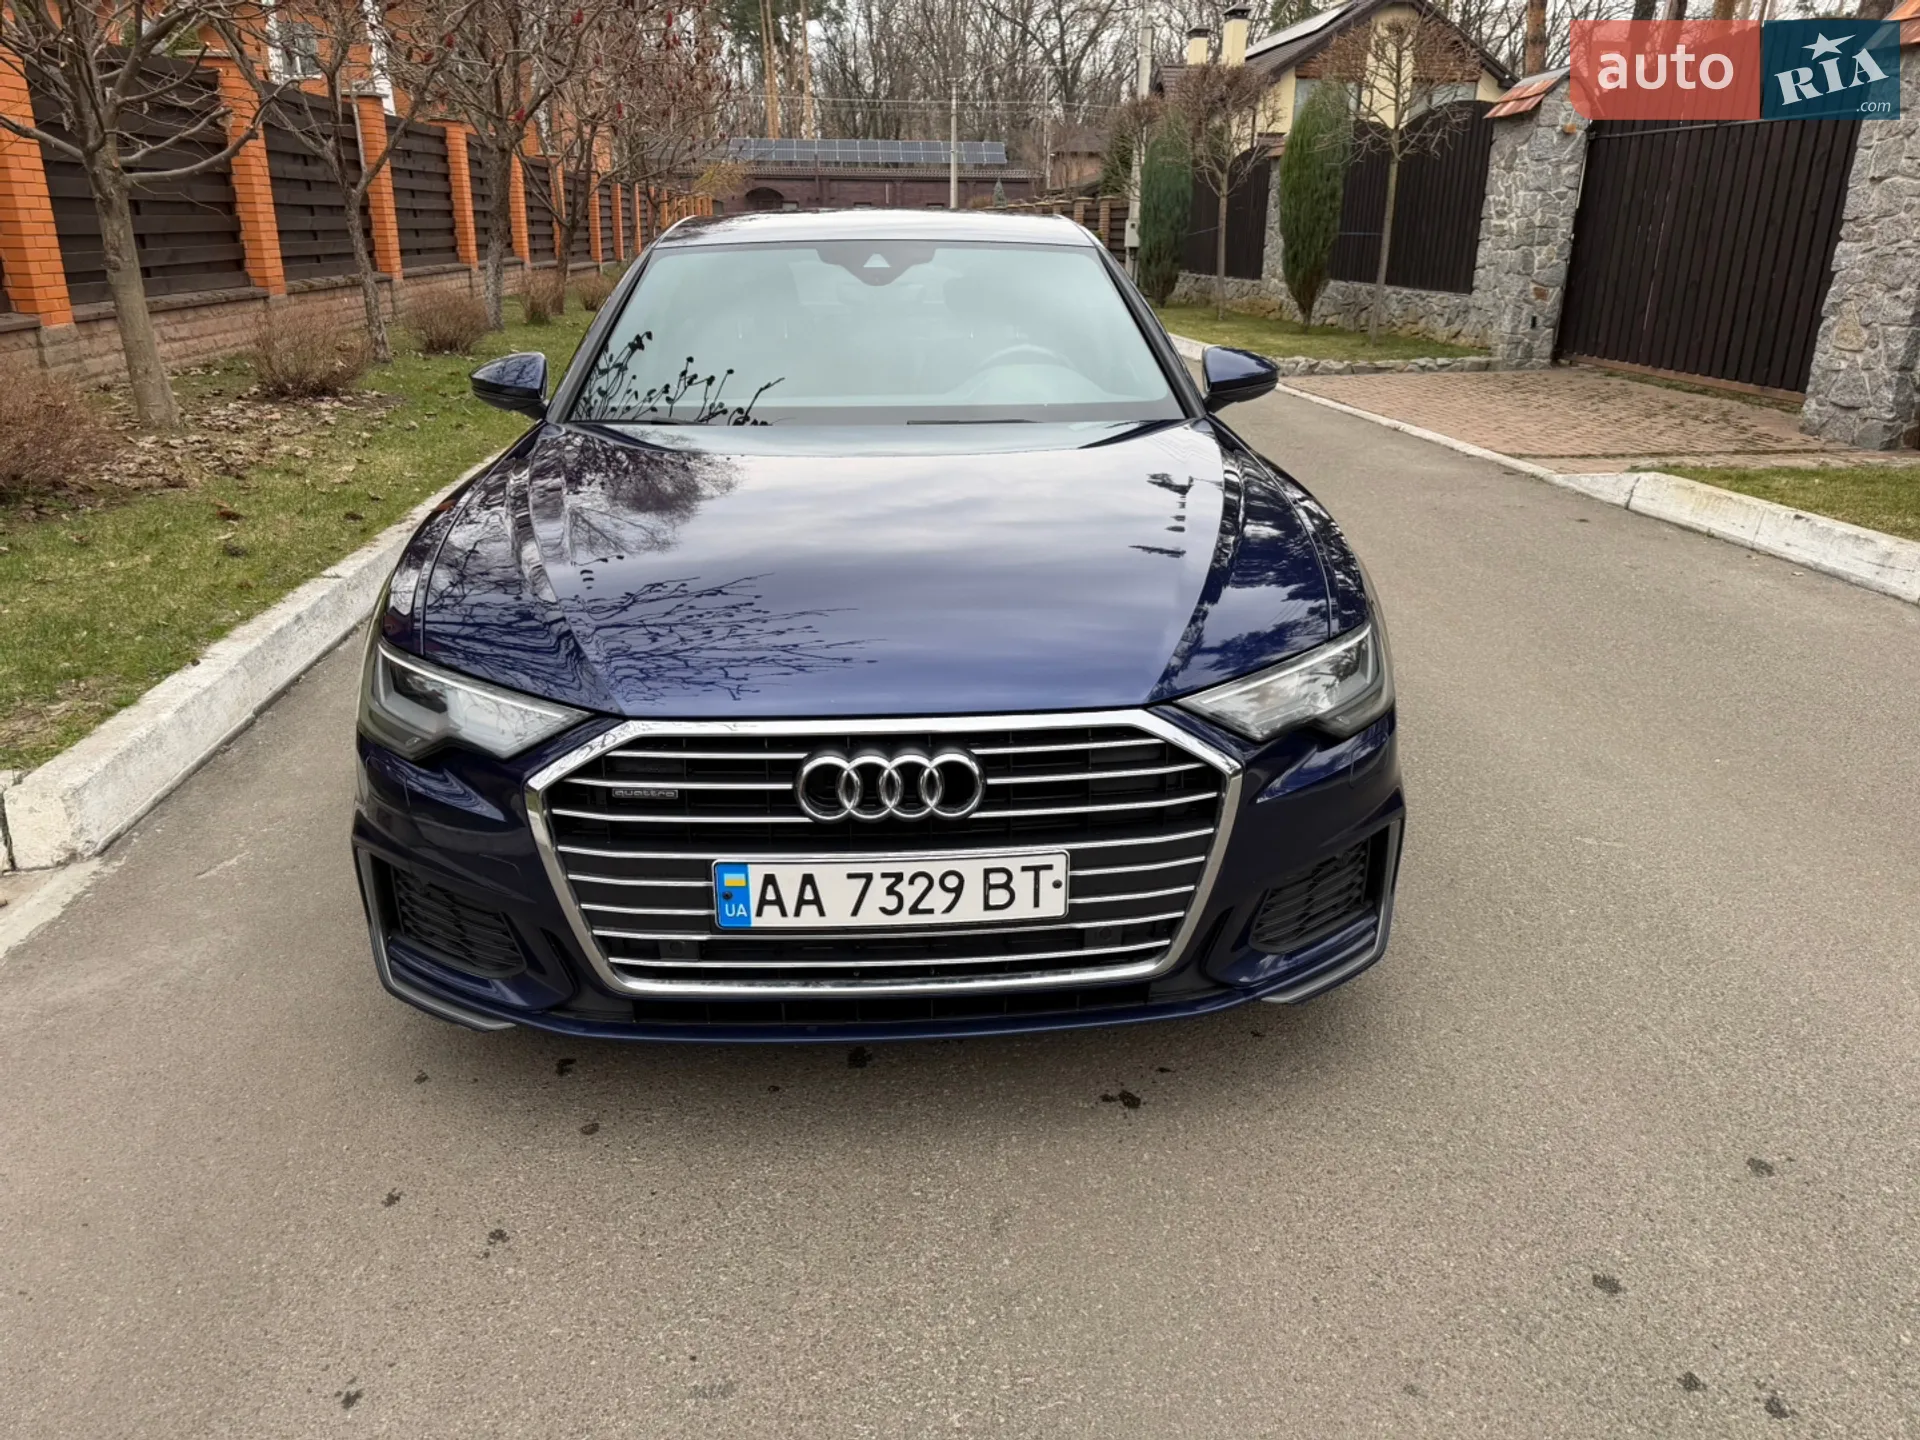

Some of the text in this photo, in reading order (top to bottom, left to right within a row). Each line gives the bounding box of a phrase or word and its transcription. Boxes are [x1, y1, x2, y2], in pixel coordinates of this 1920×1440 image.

[614, 789, 675, 797] quattro
[755, 864, 1054, 917] AA 7329 BT
[724, 904, 748, 918] UA
